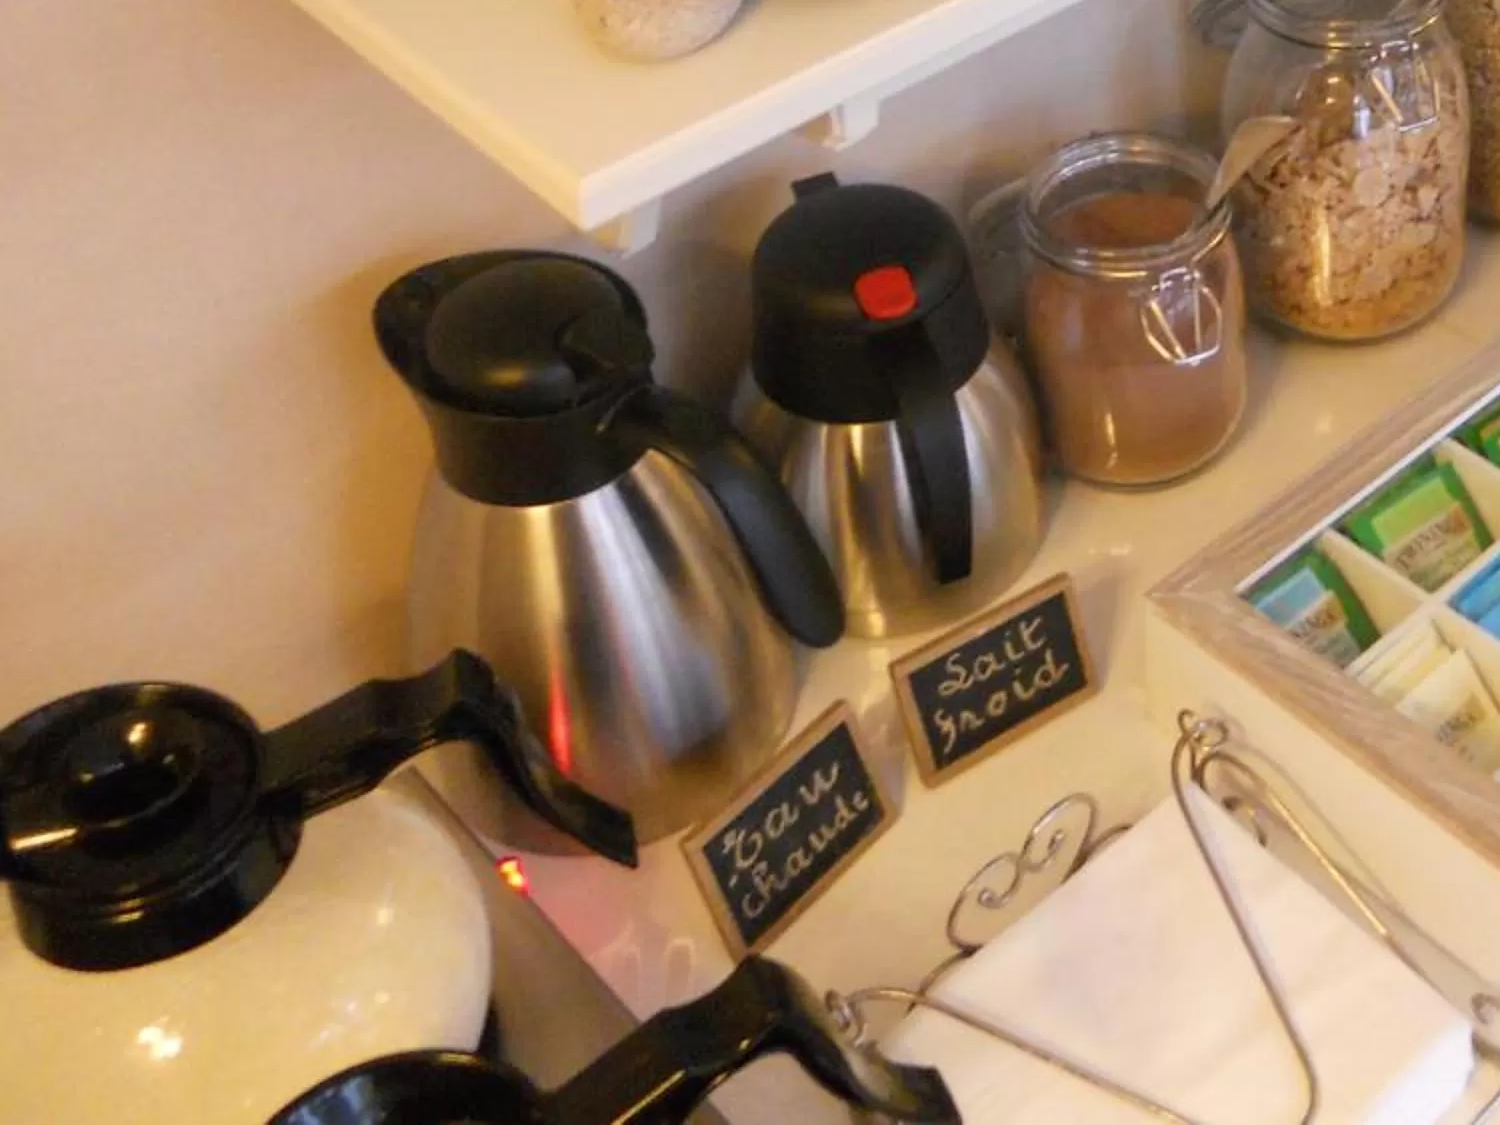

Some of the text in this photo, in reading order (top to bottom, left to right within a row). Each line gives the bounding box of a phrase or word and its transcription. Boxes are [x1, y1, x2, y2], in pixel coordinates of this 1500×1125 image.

[933, 647, 1071, 755] froid
[937, 615, 1049, 697] Lait
[722, 760, 840, 870] Eau
